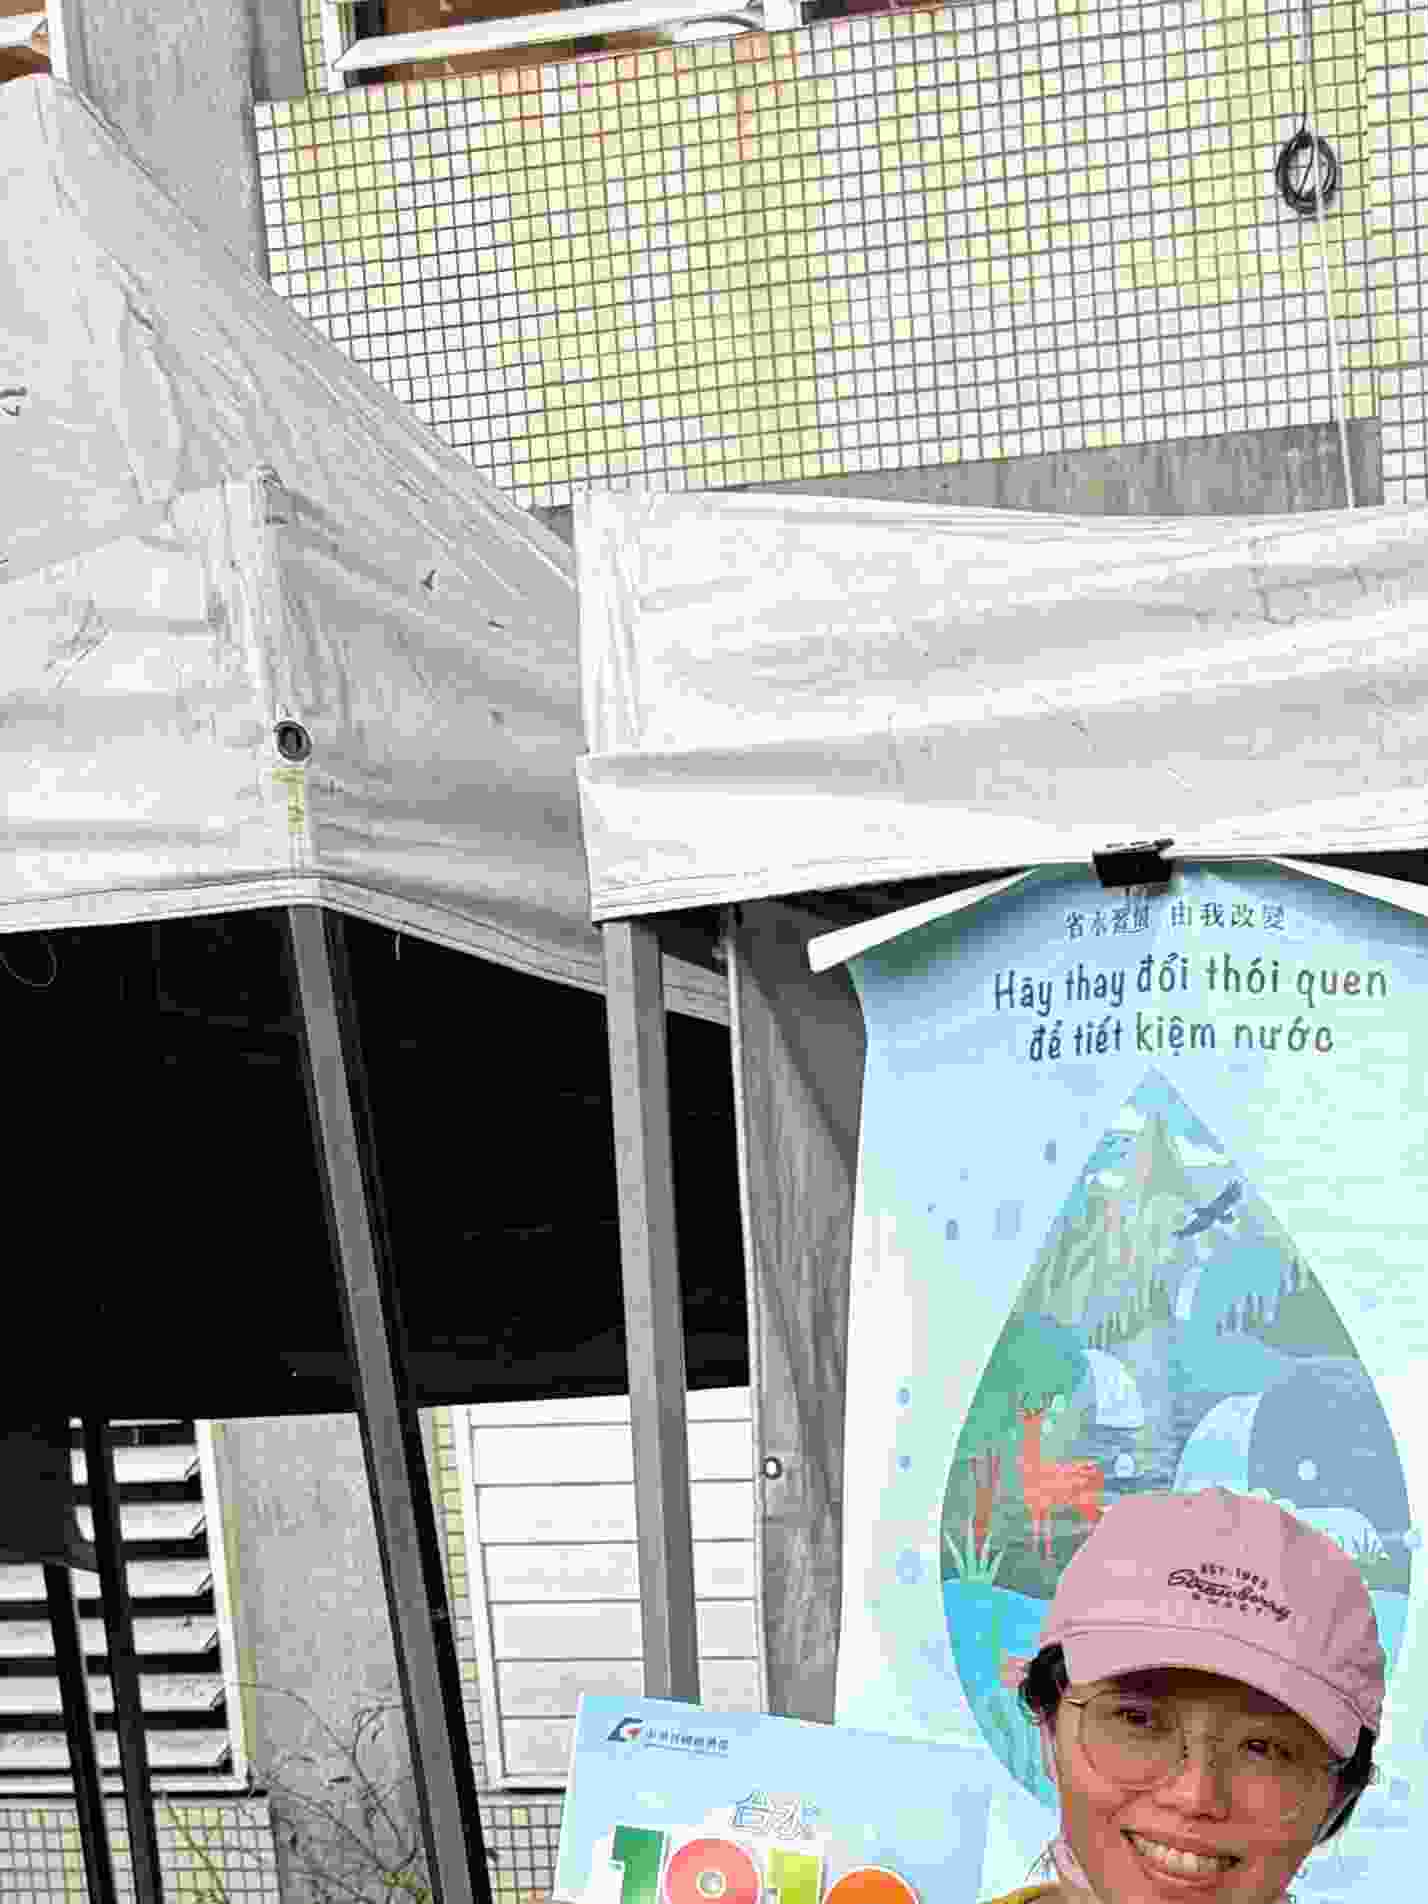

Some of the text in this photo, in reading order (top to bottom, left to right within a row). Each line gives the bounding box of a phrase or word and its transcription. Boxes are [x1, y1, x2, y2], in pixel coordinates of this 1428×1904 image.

[1171, 902, 1287, 931] 由我改變
[994, 952, 1388, 1017] Hãy thay đổi thói quen
[1029, 1011, 1335, 1062] để tiết kiệm nước
